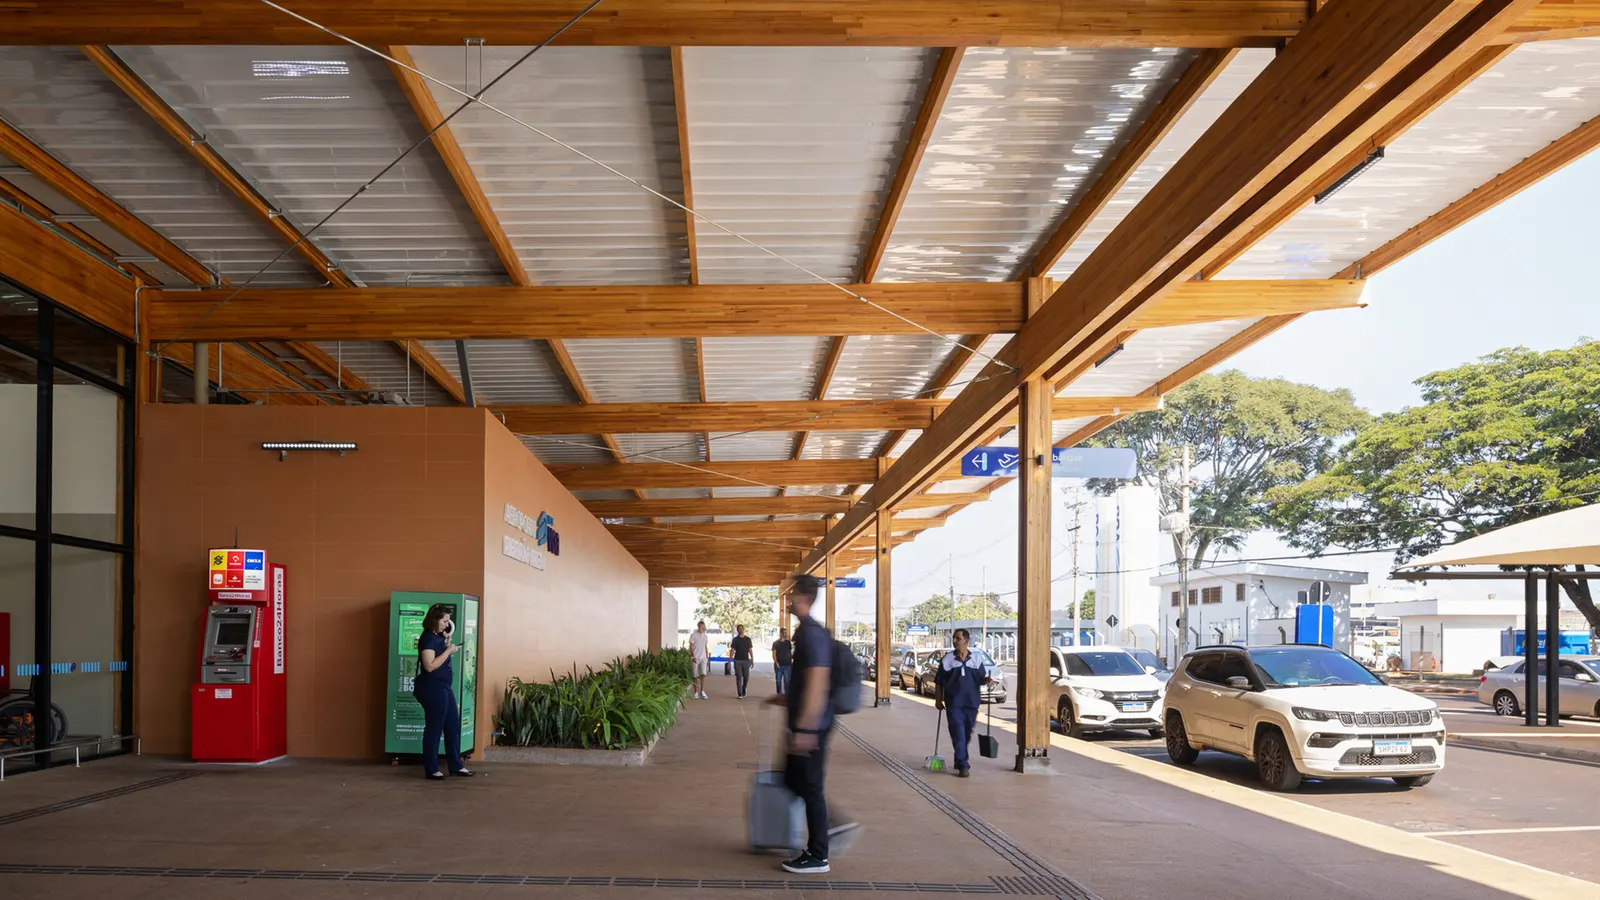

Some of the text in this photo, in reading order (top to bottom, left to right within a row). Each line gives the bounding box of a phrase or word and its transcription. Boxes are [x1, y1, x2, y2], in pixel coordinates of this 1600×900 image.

[1052, 453, 1083, 463] barque
[403, 677, 415, 685] EC
[403, 684, 415, 692] BO
